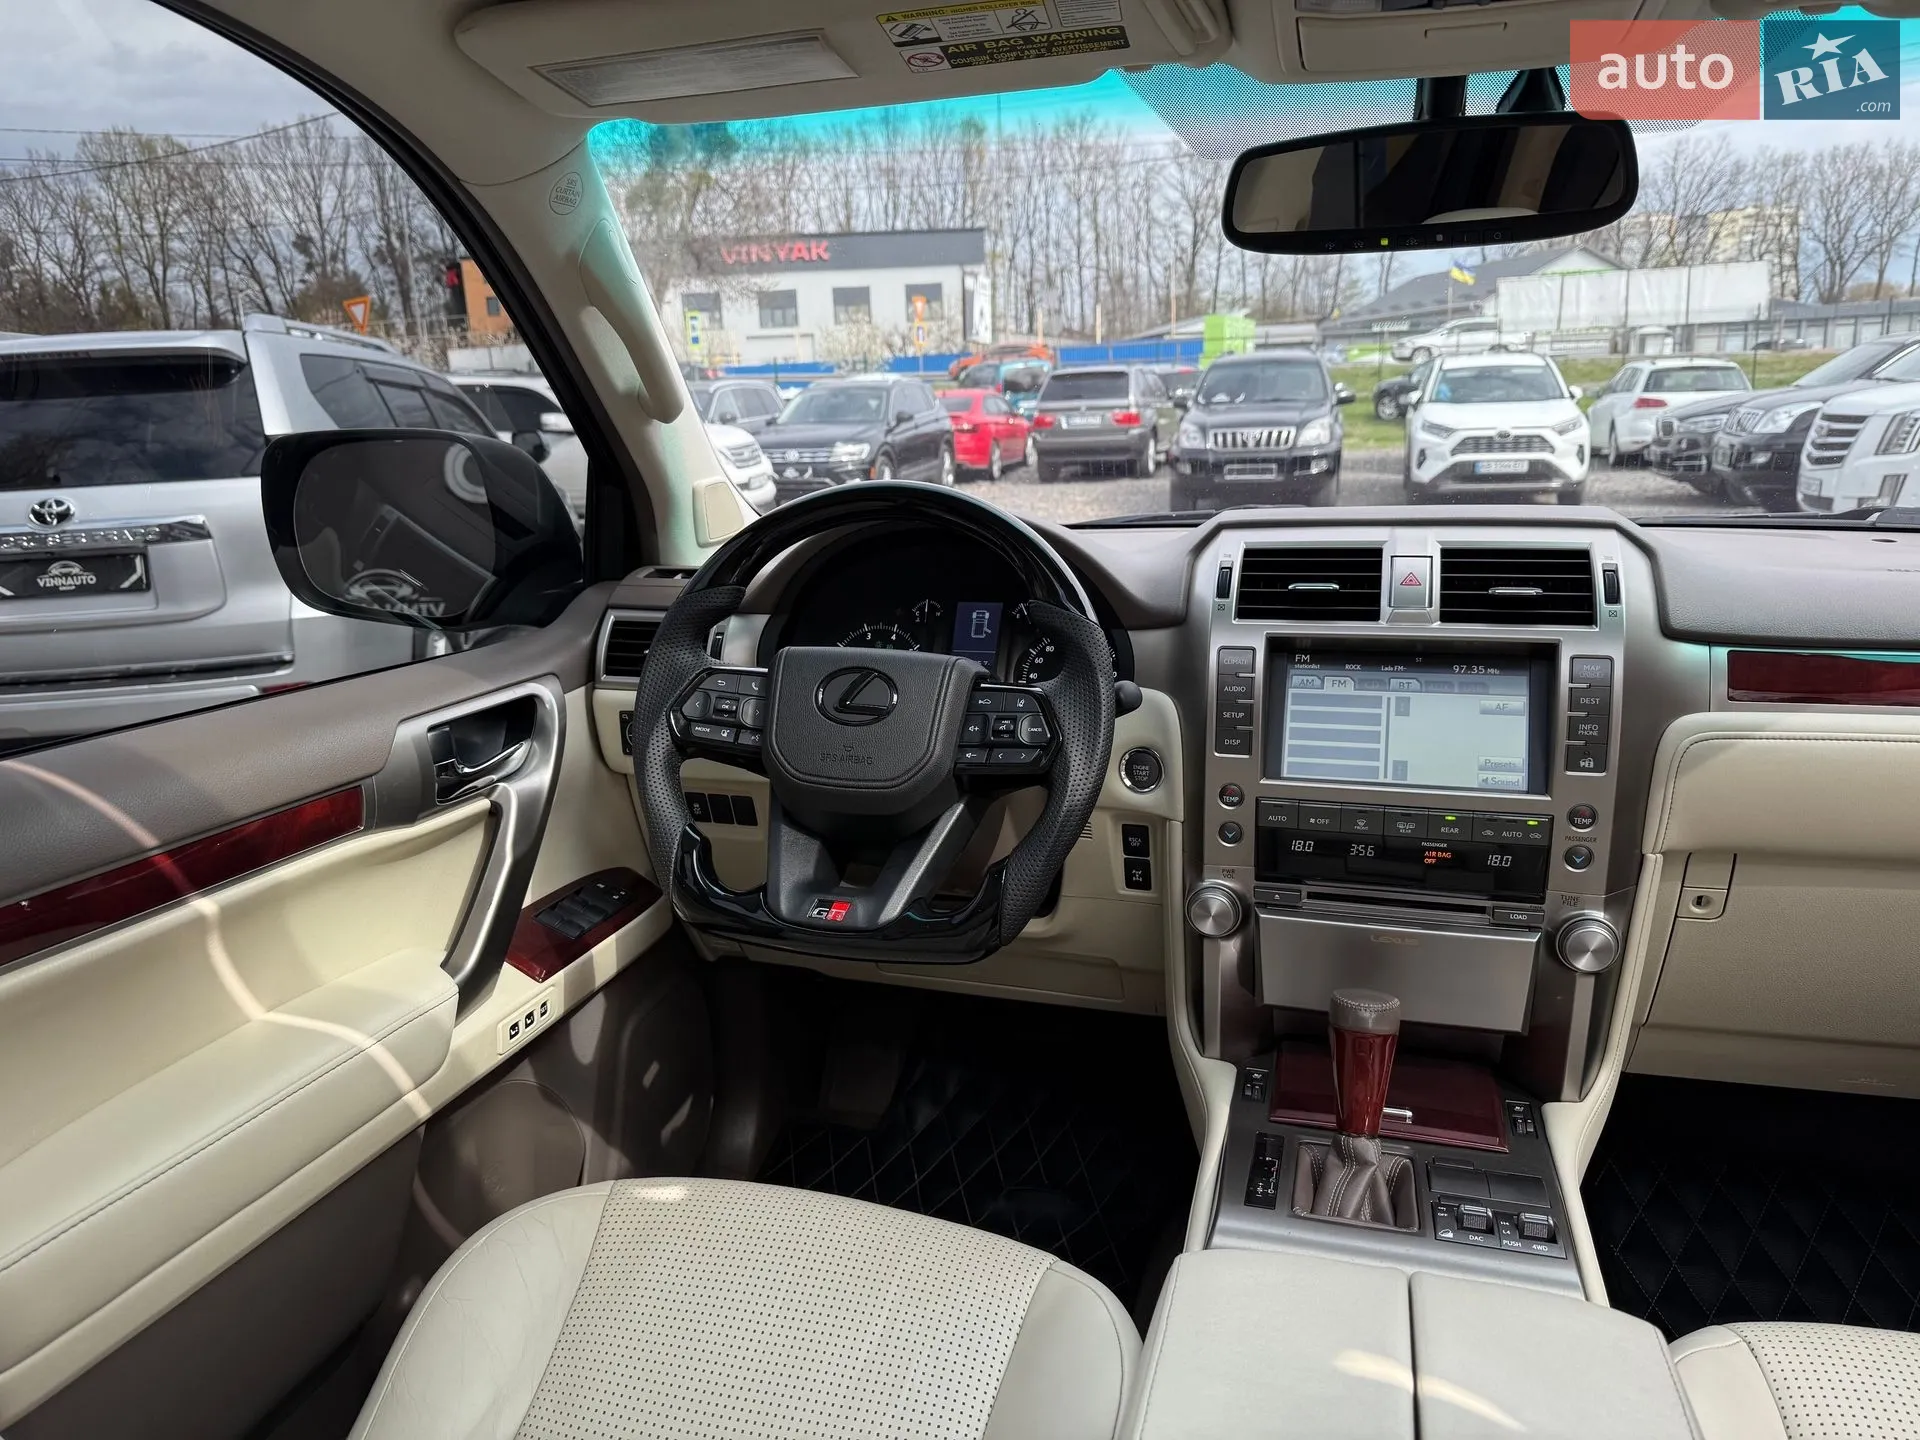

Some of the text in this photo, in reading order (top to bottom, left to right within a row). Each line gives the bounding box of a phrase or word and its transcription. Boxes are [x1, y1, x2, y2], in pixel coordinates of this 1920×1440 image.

[947, 27, 1121, 53] AIR BAG WARNING
[950, 54, 990, 66] COUSSIN
[993, 48, 1047, 60] GONFLABLE
[1051, 39, 1126, 53] AVERTISSEMENT
[719, 240, 831, 265] VINYAK
[36, 574, 97, 588] VINNAUTO
[866, 632, 871, 640] 3
[890, 633, 896, 641] 4
[1295, 654, 1311, 662] FM
[1453, 665, 1485, 674] 97.35
[1029, 672, 1038, 680] 40
[1299, 679, 1316, 687] AM
[1331, 679, 1347, 688] FM
[1580, 697, 1600, 705] DEST
[1222, 711, 1245, 719] SETUP
[1578, 723, 1599, 731] INFO
[1224, 738, 1241, 746] DISP
[840, 754, 873, 765] AIRBAG
[1490, 775, 1520, 787] Sound
[1316, 817, 1330, 825] OFF
[1573, 817, 1592, 825] TEMP
[1440, 826, 1460, 834] REAR
[1564, 835, 1598, 843] PASSENGER
[1291, 840, 1315, 852] 18.0
[1350, 843, 1375, 857] 3:56
[1424, 850, 1452, 859] AIR BAG
[1487, 853, 1512, 867] 18.0
[1509, 913, 1528, 921] LOAD
[1502, 1240, 1522, 1248] PUSH
